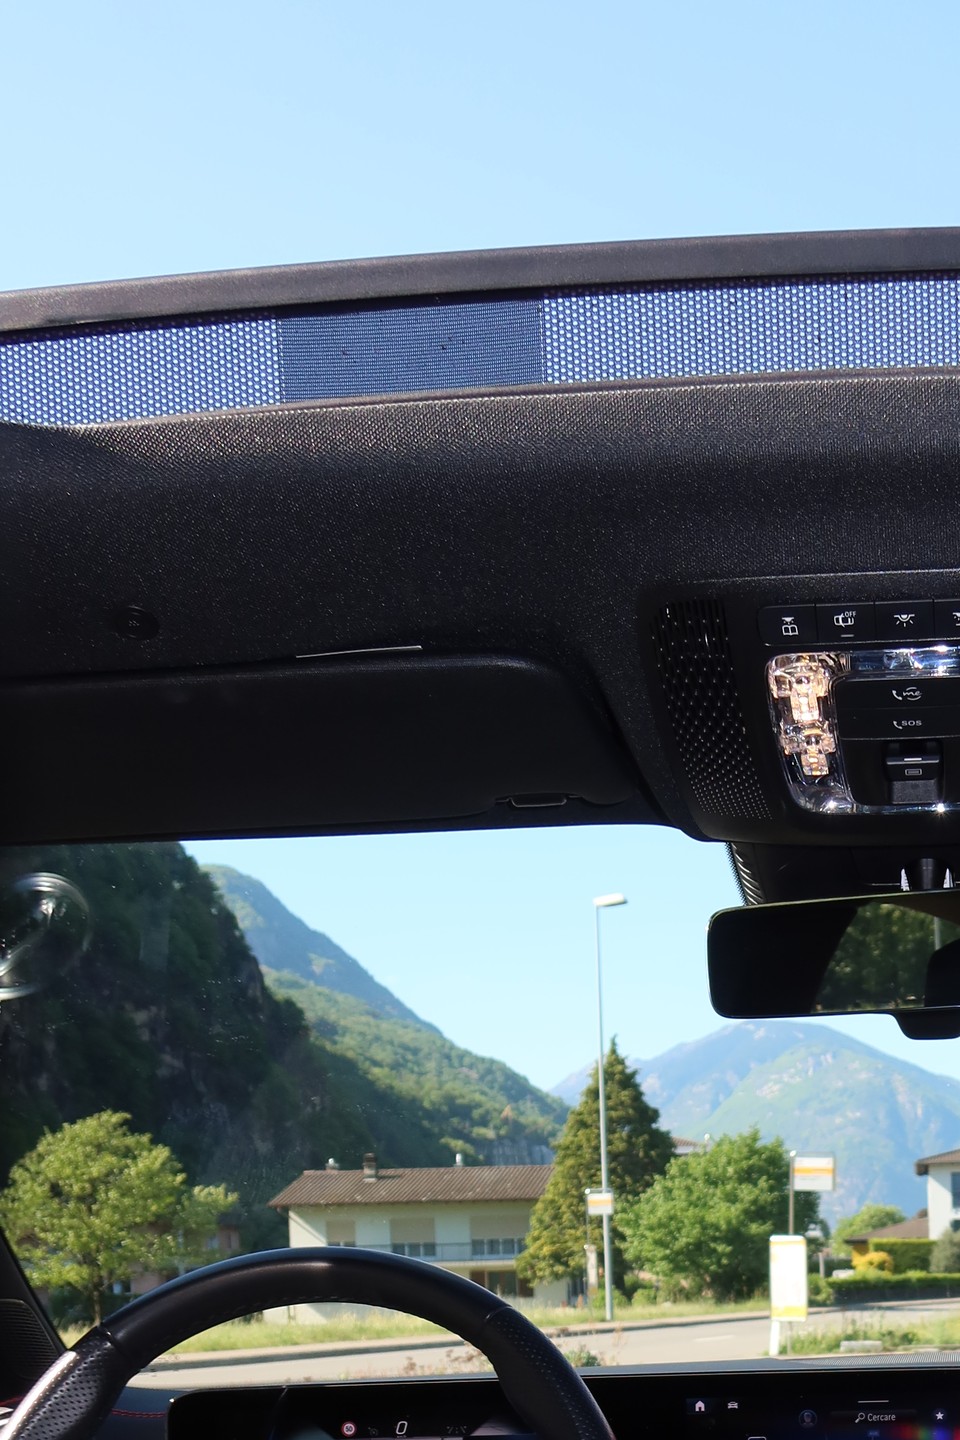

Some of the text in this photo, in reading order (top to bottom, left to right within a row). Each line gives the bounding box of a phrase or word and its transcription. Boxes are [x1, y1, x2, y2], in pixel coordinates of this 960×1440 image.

[867, 1412, 896, 1422] Cercare
[345, 1424, 353, 1433] 50
[396, 1420, 408, 1435] 0
